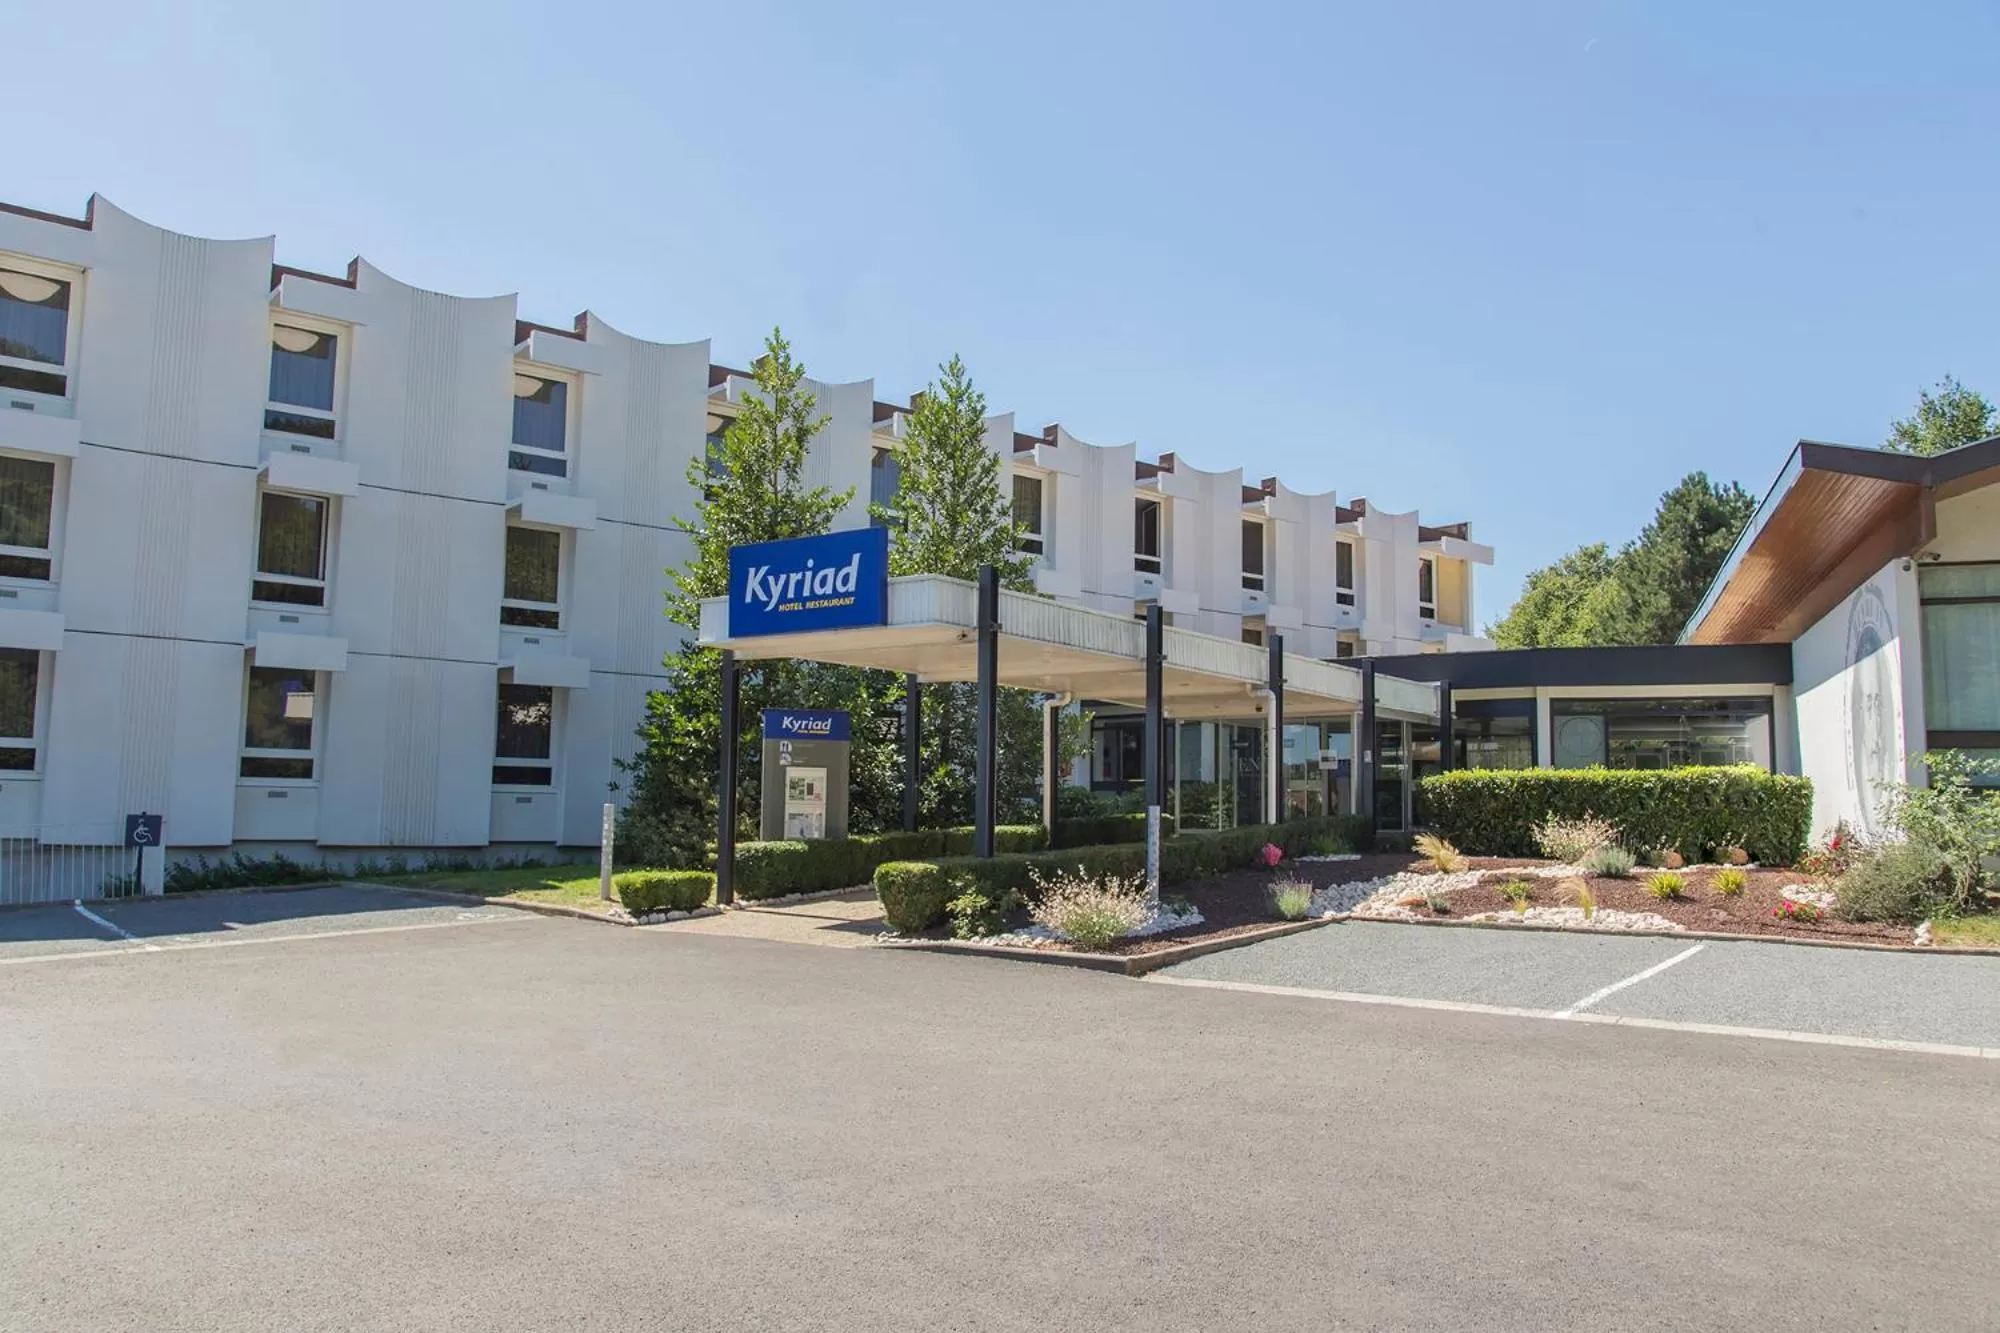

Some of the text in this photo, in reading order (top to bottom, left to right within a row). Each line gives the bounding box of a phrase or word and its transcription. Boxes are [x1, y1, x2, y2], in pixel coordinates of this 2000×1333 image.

[745, 552, 862, 612] Kyriad
[778, 596, 856, 612] HOTEL RESTAURANT
[782, 716, 832, 733] Kyriad
